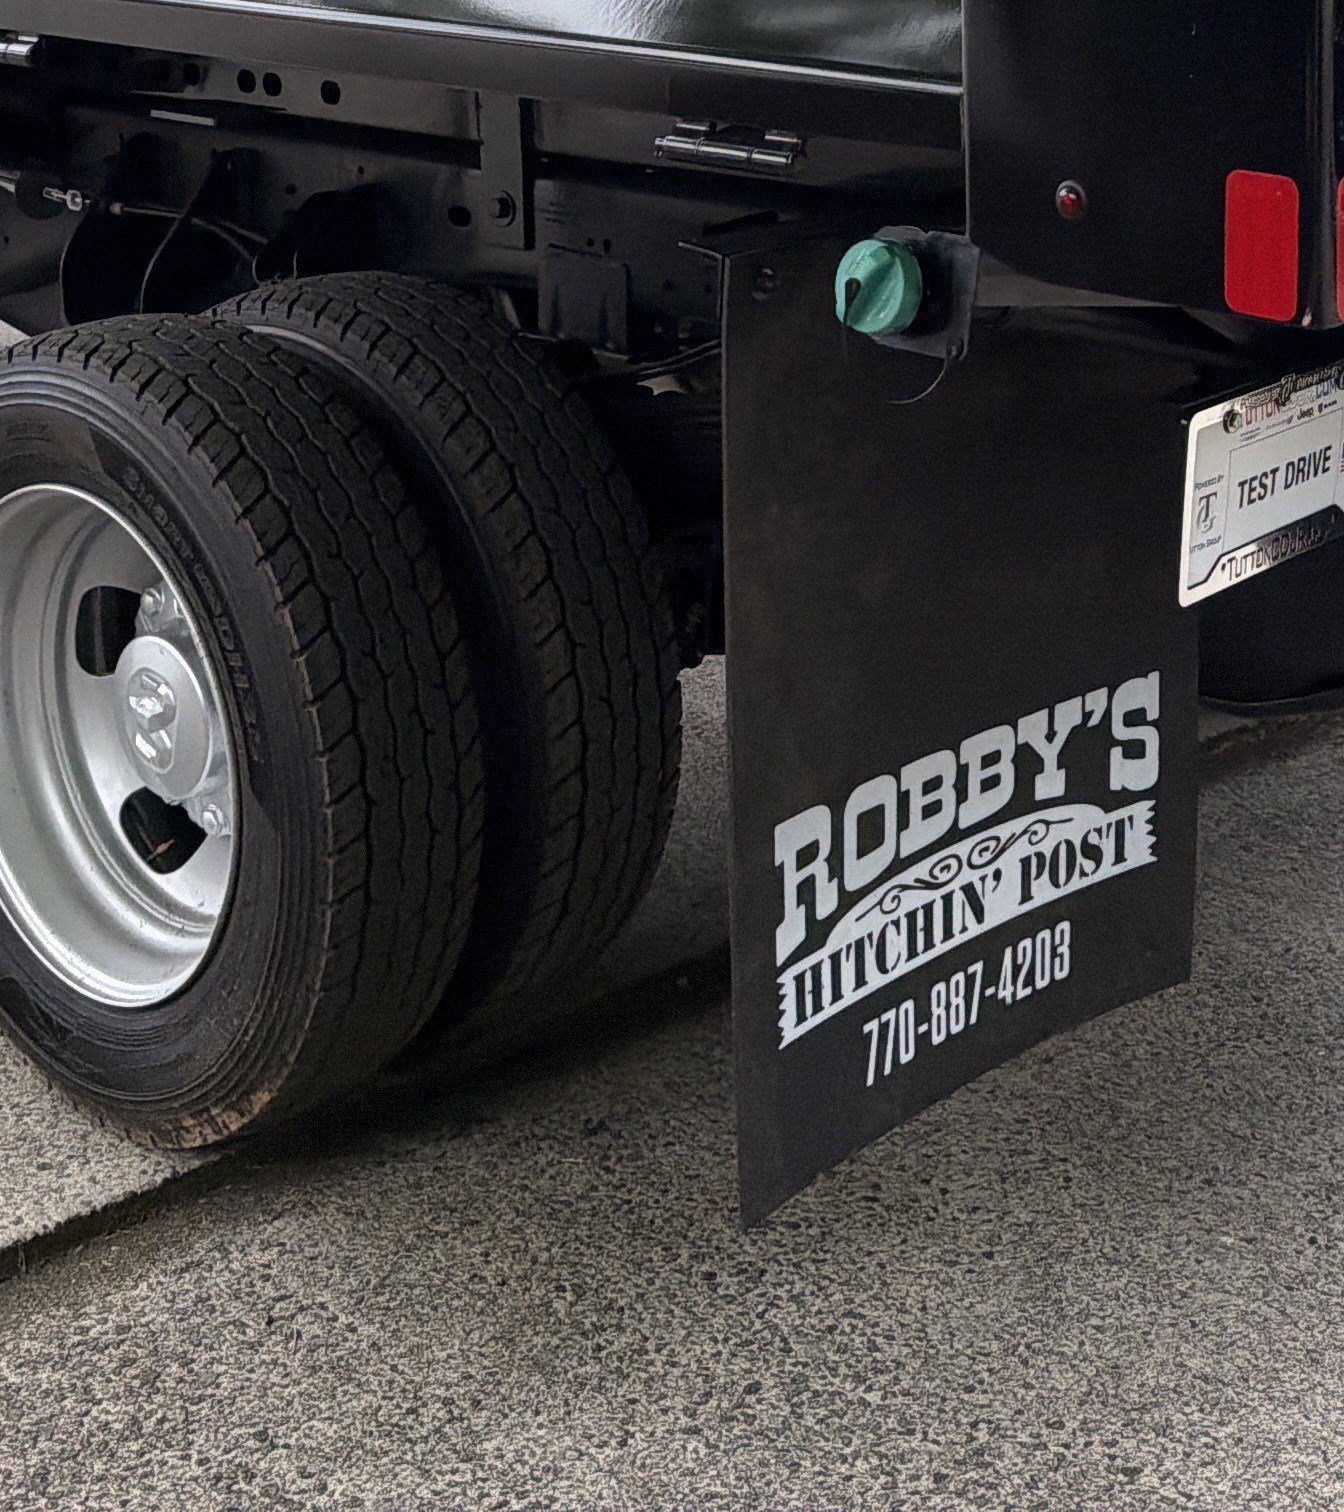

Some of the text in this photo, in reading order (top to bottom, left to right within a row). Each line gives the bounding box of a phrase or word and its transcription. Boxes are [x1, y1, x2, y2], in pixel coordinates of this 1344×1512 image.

[1237, 444, 1333, 510] TEST DRIVE
[774, 670, 1160, 968] ROBBY'S
[792, 814, 1135, 1029] HITCHIN' POST
[862, 920, 1072, 1088] 770-887-4203
